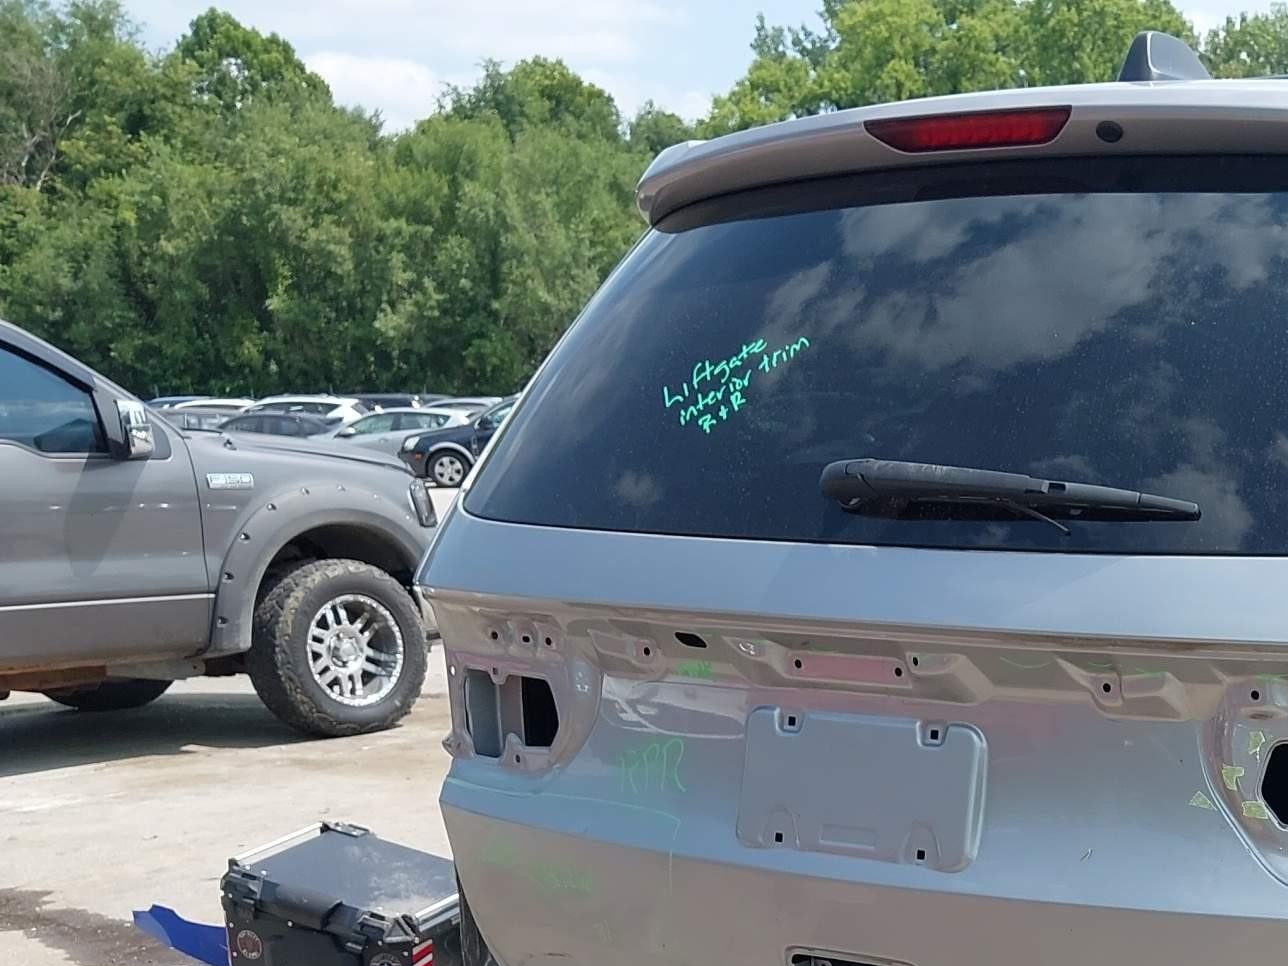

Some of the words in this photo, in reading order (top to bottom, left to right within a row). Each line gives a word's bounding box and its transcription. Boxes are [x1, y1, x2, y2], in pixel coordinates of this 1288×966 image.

[680, 369, 752, 426] interior
[758, 336, 810, 373] trim
[730, 391, 747, 412] R
